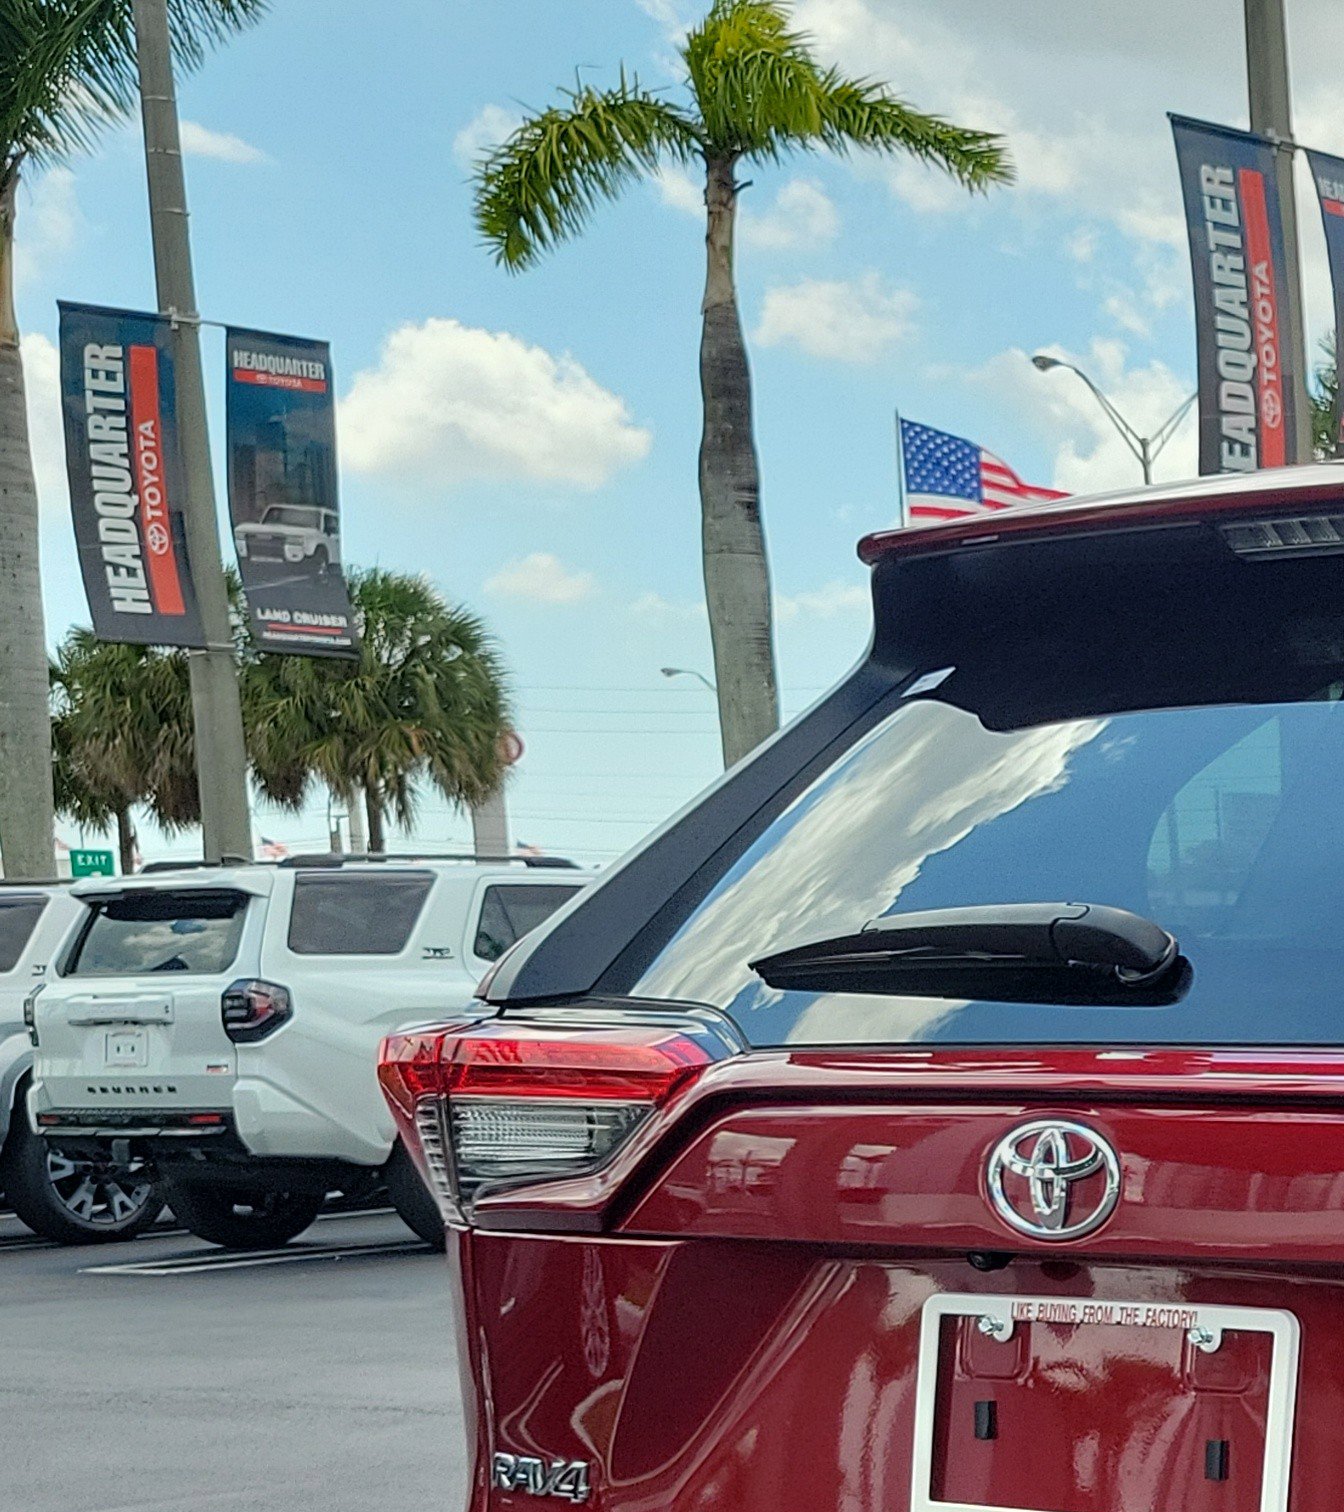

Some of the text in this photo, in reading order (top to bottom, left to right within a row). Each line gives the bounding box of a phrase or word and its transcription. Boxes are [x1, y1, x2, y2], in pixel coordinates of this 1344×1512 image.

[1201, 164, 1258, 475] EADQUARTER
[1251, 260, 1278, 386] TOYOTA
[233, 350, 325, 380] HEADQUARTER
[84, 342, 153, 615] HEADQUARTER
[139, 419, 164, 520] TOYOTA
[256, 607, 348, 628] LAND CRUISER
[77, 854, 107, 866] EXIT
[1011, 1302, 1033, 1320] LIKE
[1038, 1303, 1077, 1323] BUYING
[1083, 1305, 1114, 1325] FROM
[1119, 1307, 1140, 1325] THE
[493, 1452, 590, 1503] RAV4
